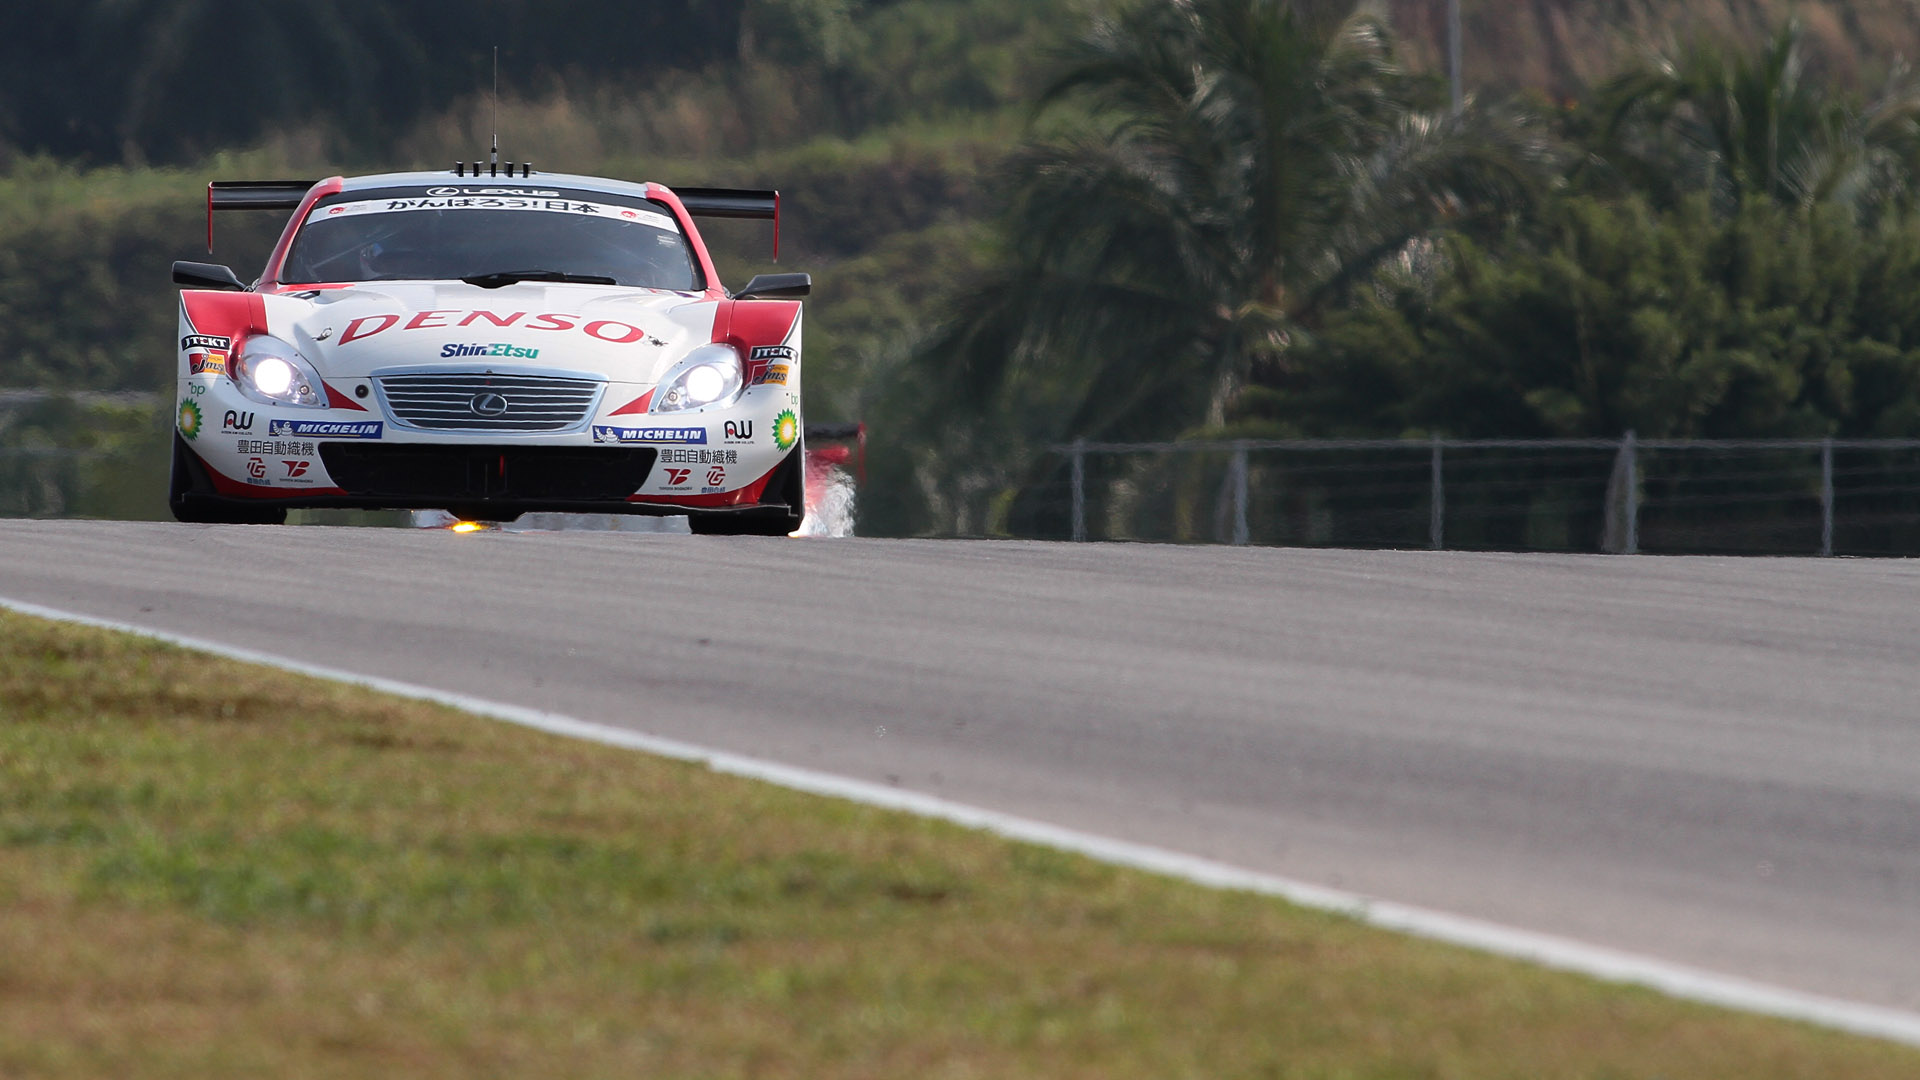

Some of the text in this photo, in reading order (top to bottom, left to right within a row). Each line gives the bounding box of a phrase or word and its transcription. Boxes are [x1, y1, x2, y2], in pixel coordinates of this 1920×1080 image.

[463, 188, 560, 197] LEXUS
[338, 310, 645, 346] DENSO
[185, 336, 227, 347] JTEKT
[191, 382, 205, 396] bp
[297, 423, 379, 434] MICHELIN
[622, 429, 702, 440] MICHELIN
